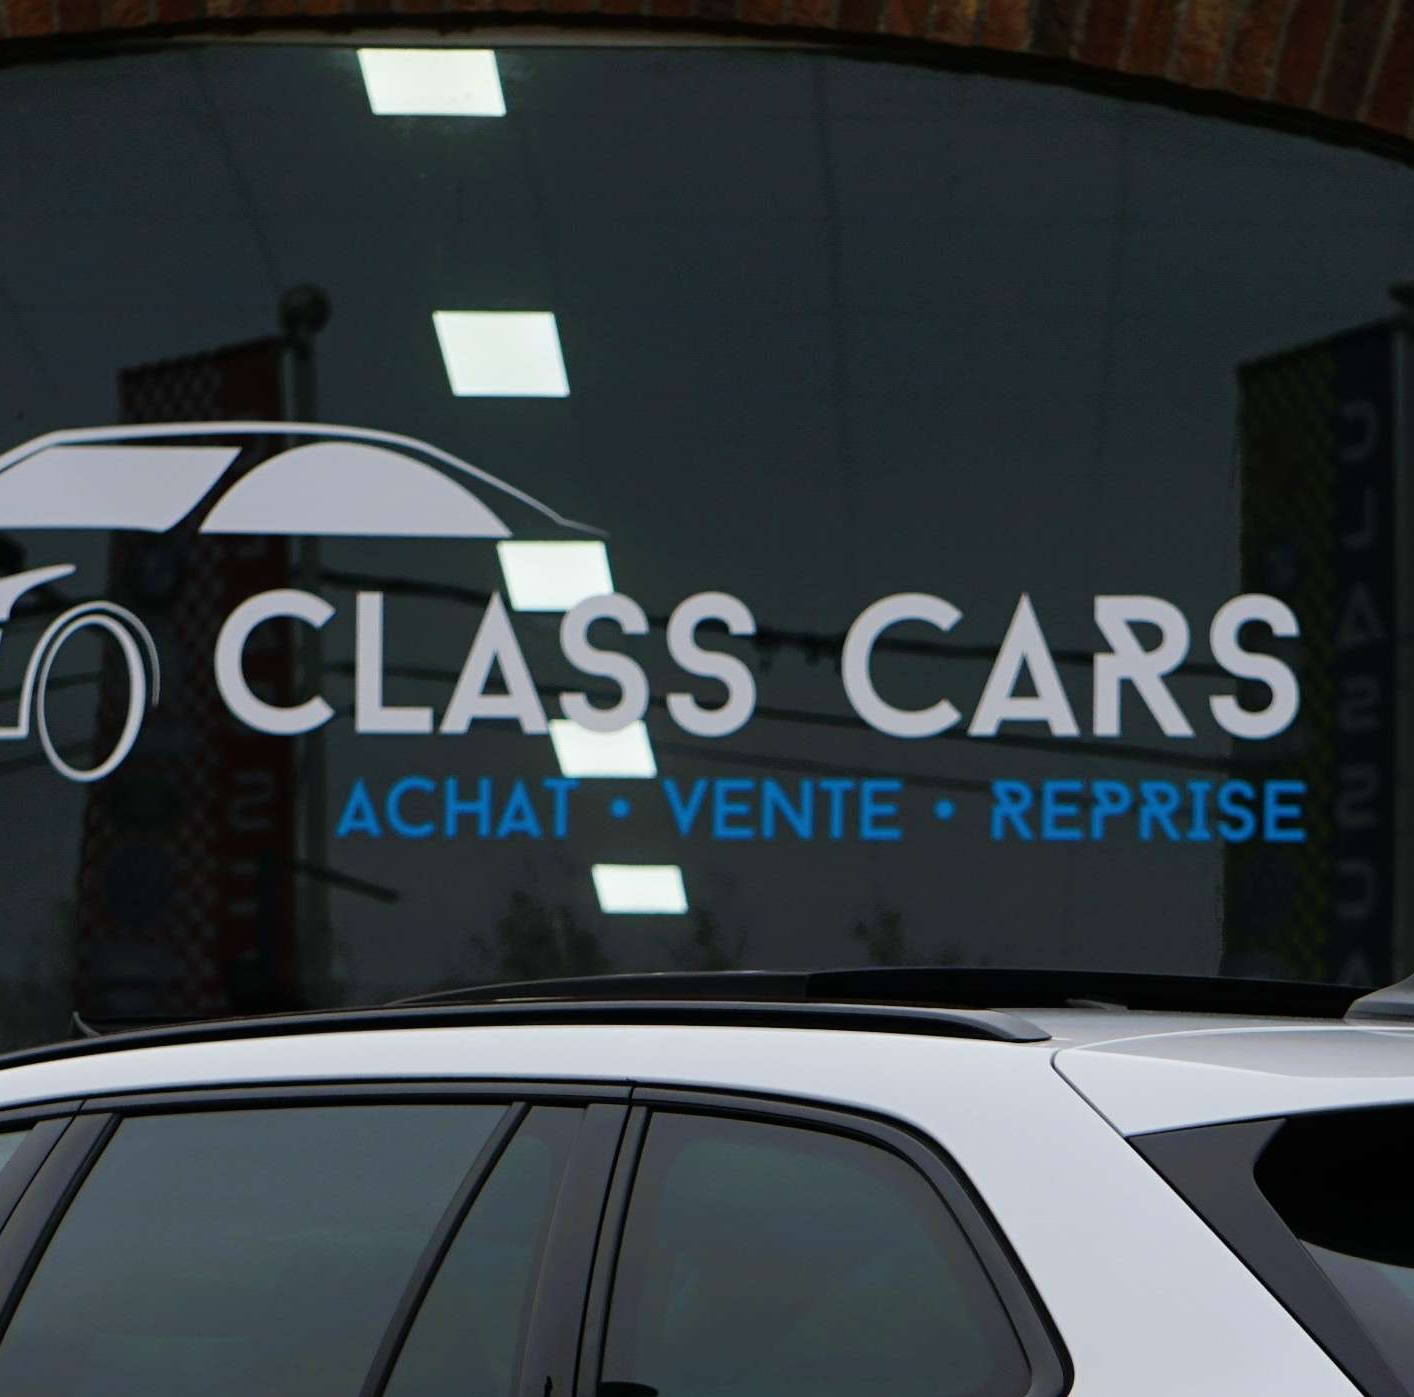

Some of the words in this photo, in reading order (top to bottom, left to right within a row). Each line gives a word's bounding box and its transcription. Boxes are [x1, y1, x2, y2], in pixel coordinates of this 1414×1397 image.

[214, 588, 757, 737] CLASS
[841, 592, 1301, 740] CARS
[335, 776, 579, 839] ACHAT
[663, 778, 903, 840] VENTE
[990, 780, 1307, 842] REPRISE
